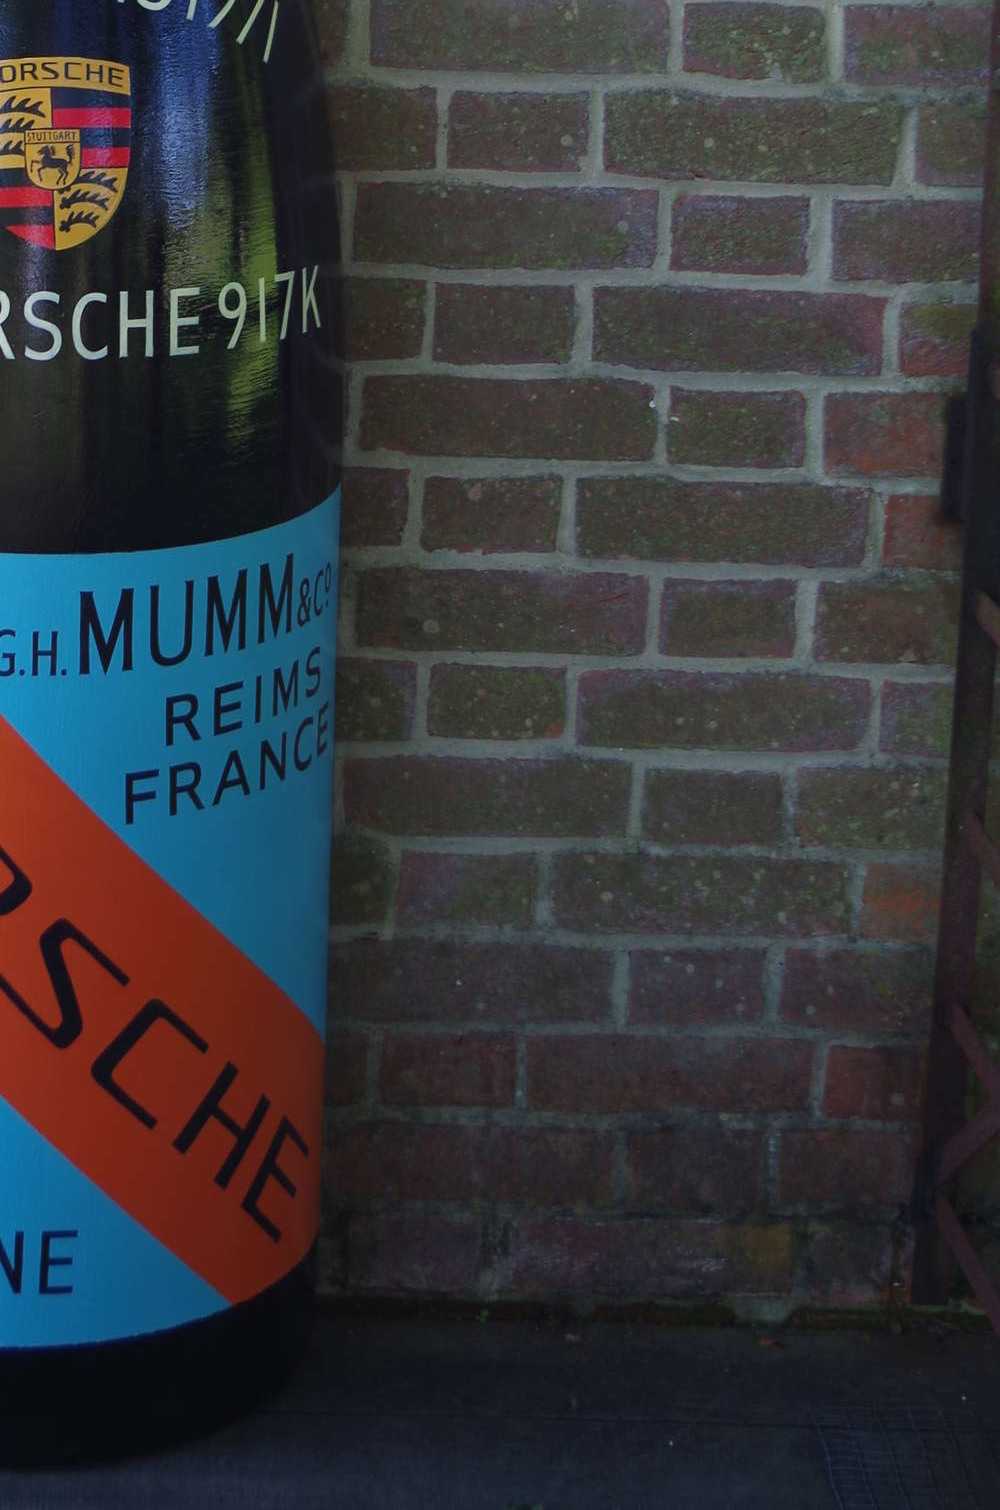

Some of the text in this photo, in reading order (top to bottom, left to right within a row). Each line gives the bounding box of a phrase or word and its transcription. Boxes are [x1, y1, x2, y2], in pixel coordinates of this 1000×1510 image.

[26, 130, 78, 142] STUTTGART
[217, 264, 322, 351] 917K
[164, 645, 322, 747] REIMS
[124, 702, 330, 826] FRANCE
